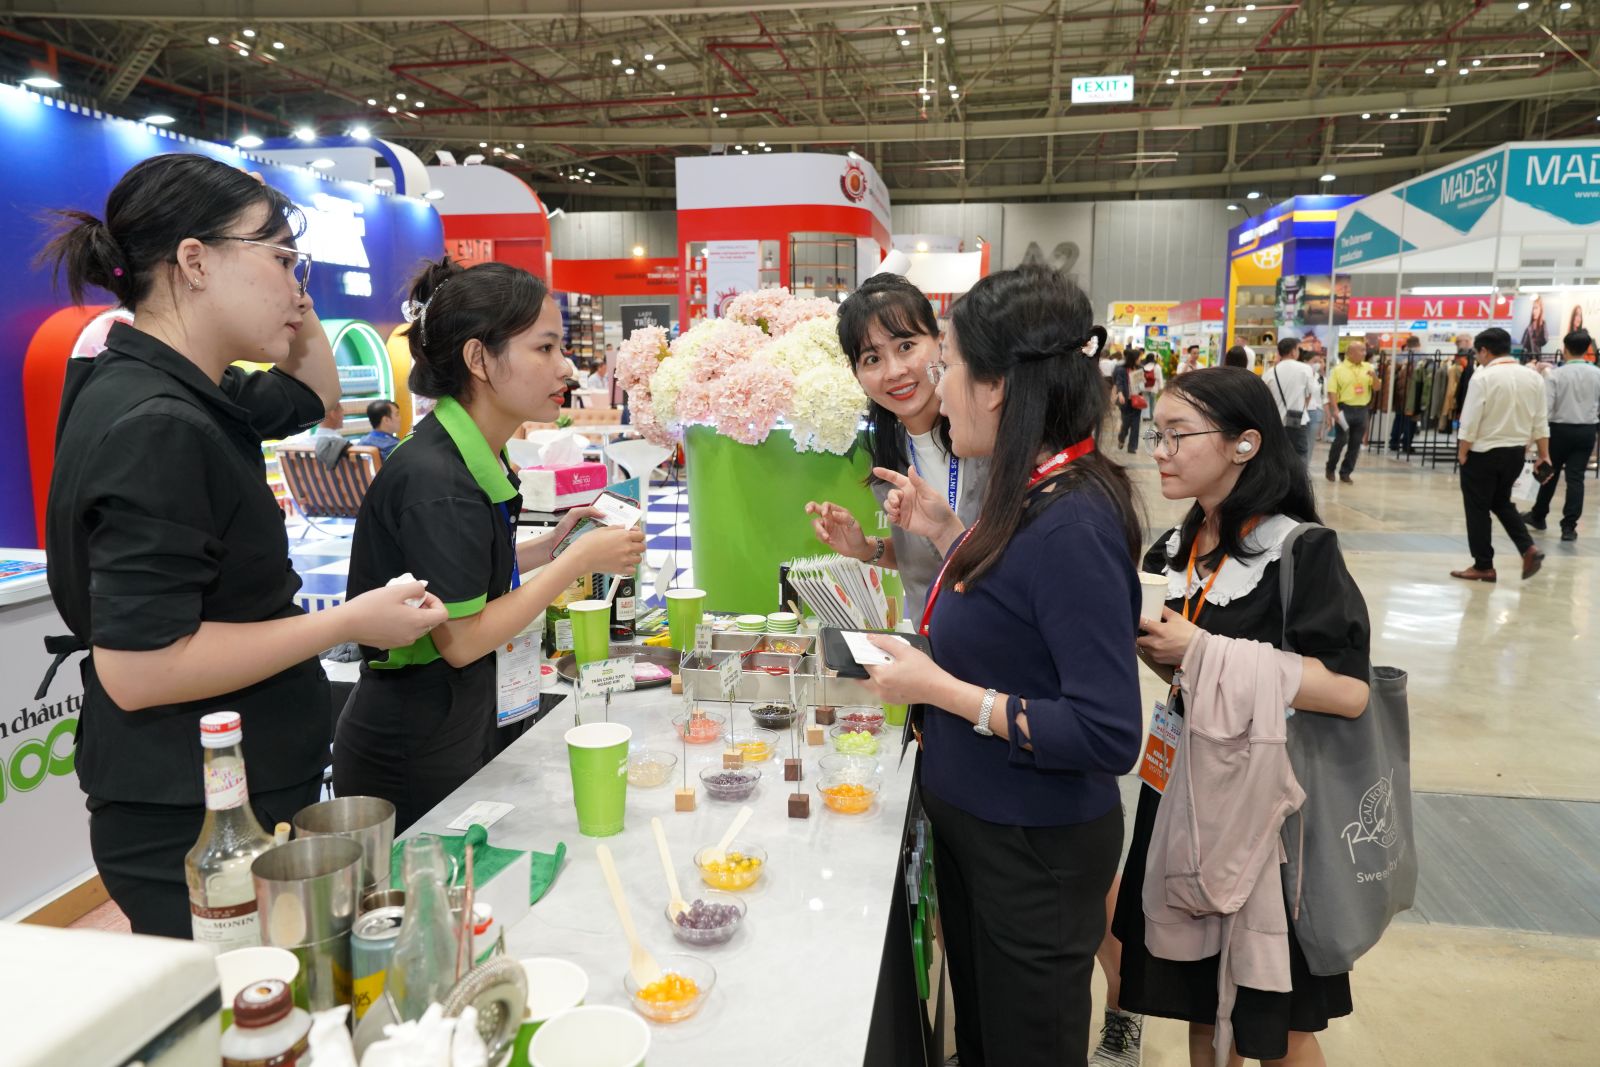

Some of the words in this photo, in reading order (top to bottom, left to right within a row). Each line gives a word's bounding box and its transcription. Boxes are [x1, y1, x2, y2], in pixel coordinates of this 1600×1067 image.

[1084, 80, 1120, 92] EXIT
[1440, 159, 1498, 205] MADEX
[1018, 241, 1080, 275] A2
[949, 471, 958, 490] INT'L
[213, 916, 254, 929] MONIN
